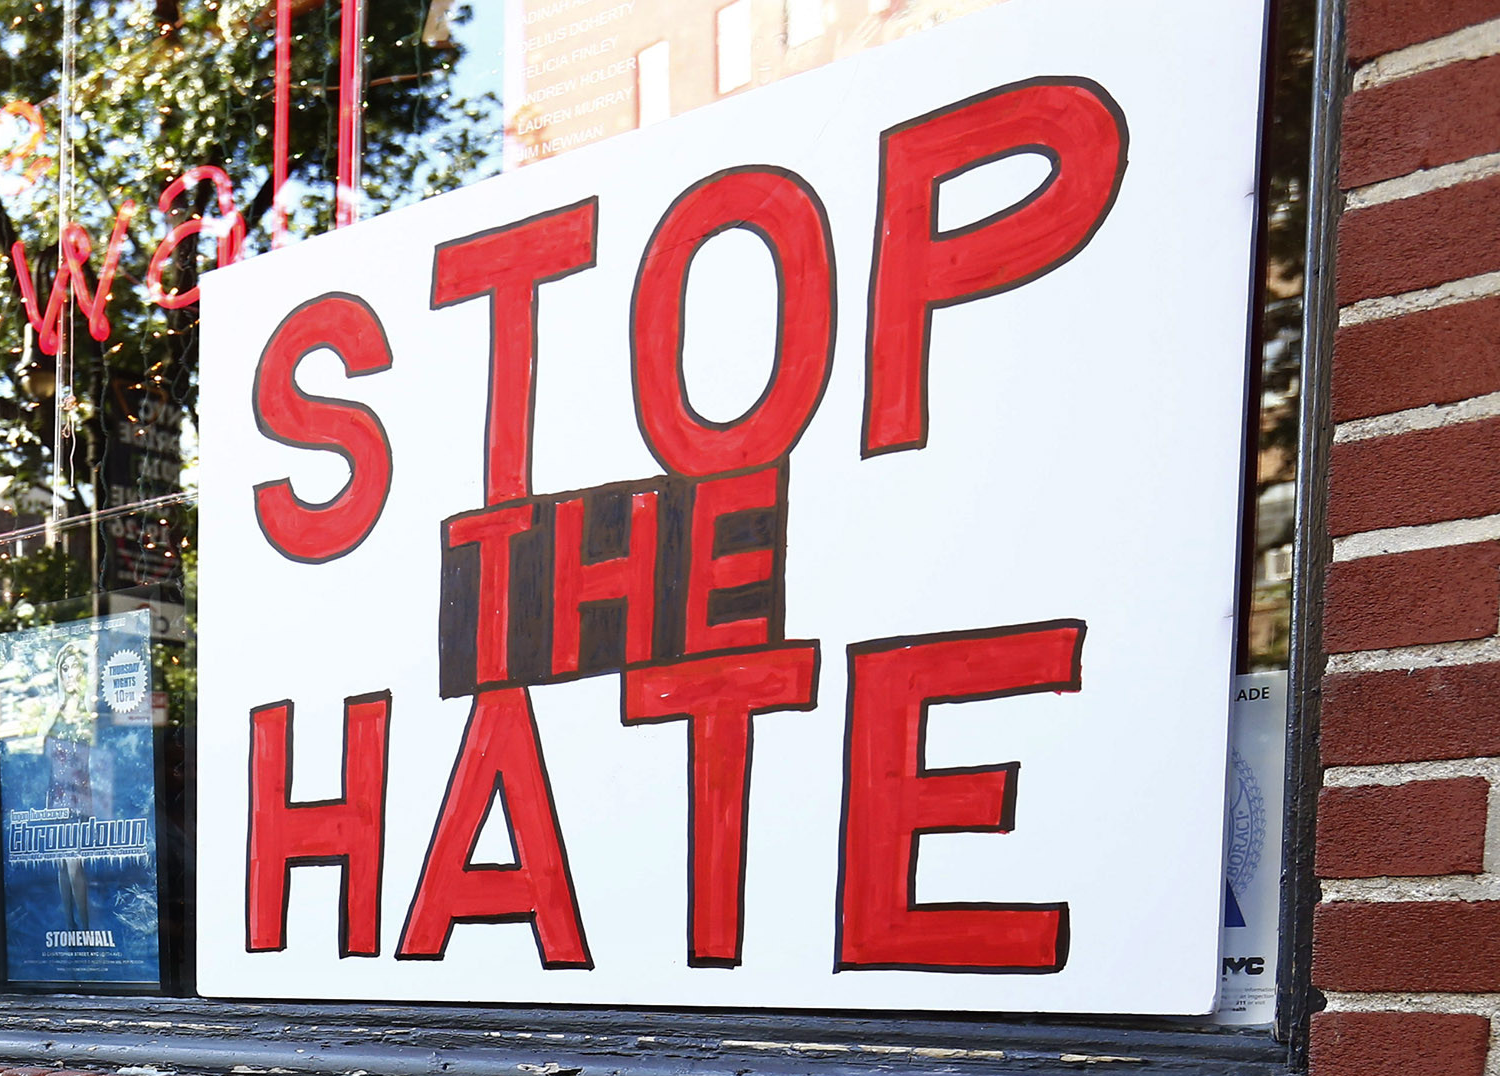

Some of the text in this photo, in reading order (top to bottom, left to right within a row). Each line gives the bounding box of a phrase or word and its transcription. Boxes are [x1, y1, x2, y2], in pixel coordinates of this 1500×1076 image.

[569, 1, 636, 35] DOHERTY
[572, 34, 620, 63] FINLEY
[580, 57, 637, 86] HOLDER
[518, 86, 634, 135] LAUREN MURRAY
[542, 121, 605, 154] NEWMAN
[251, 75, 1130, 565] STOP
[444, 458, 787, 695] THE
[109, 664, 140, 676] THURSDAY
[113, 676, 136, 689] NIGHTS
[1235, 686, 1270, 702] ADE
[245, 618, 1087, 974] HATE
[45, 930, 116, 948] STONEWALL
[1222, 956, 1265, 975] NYC
